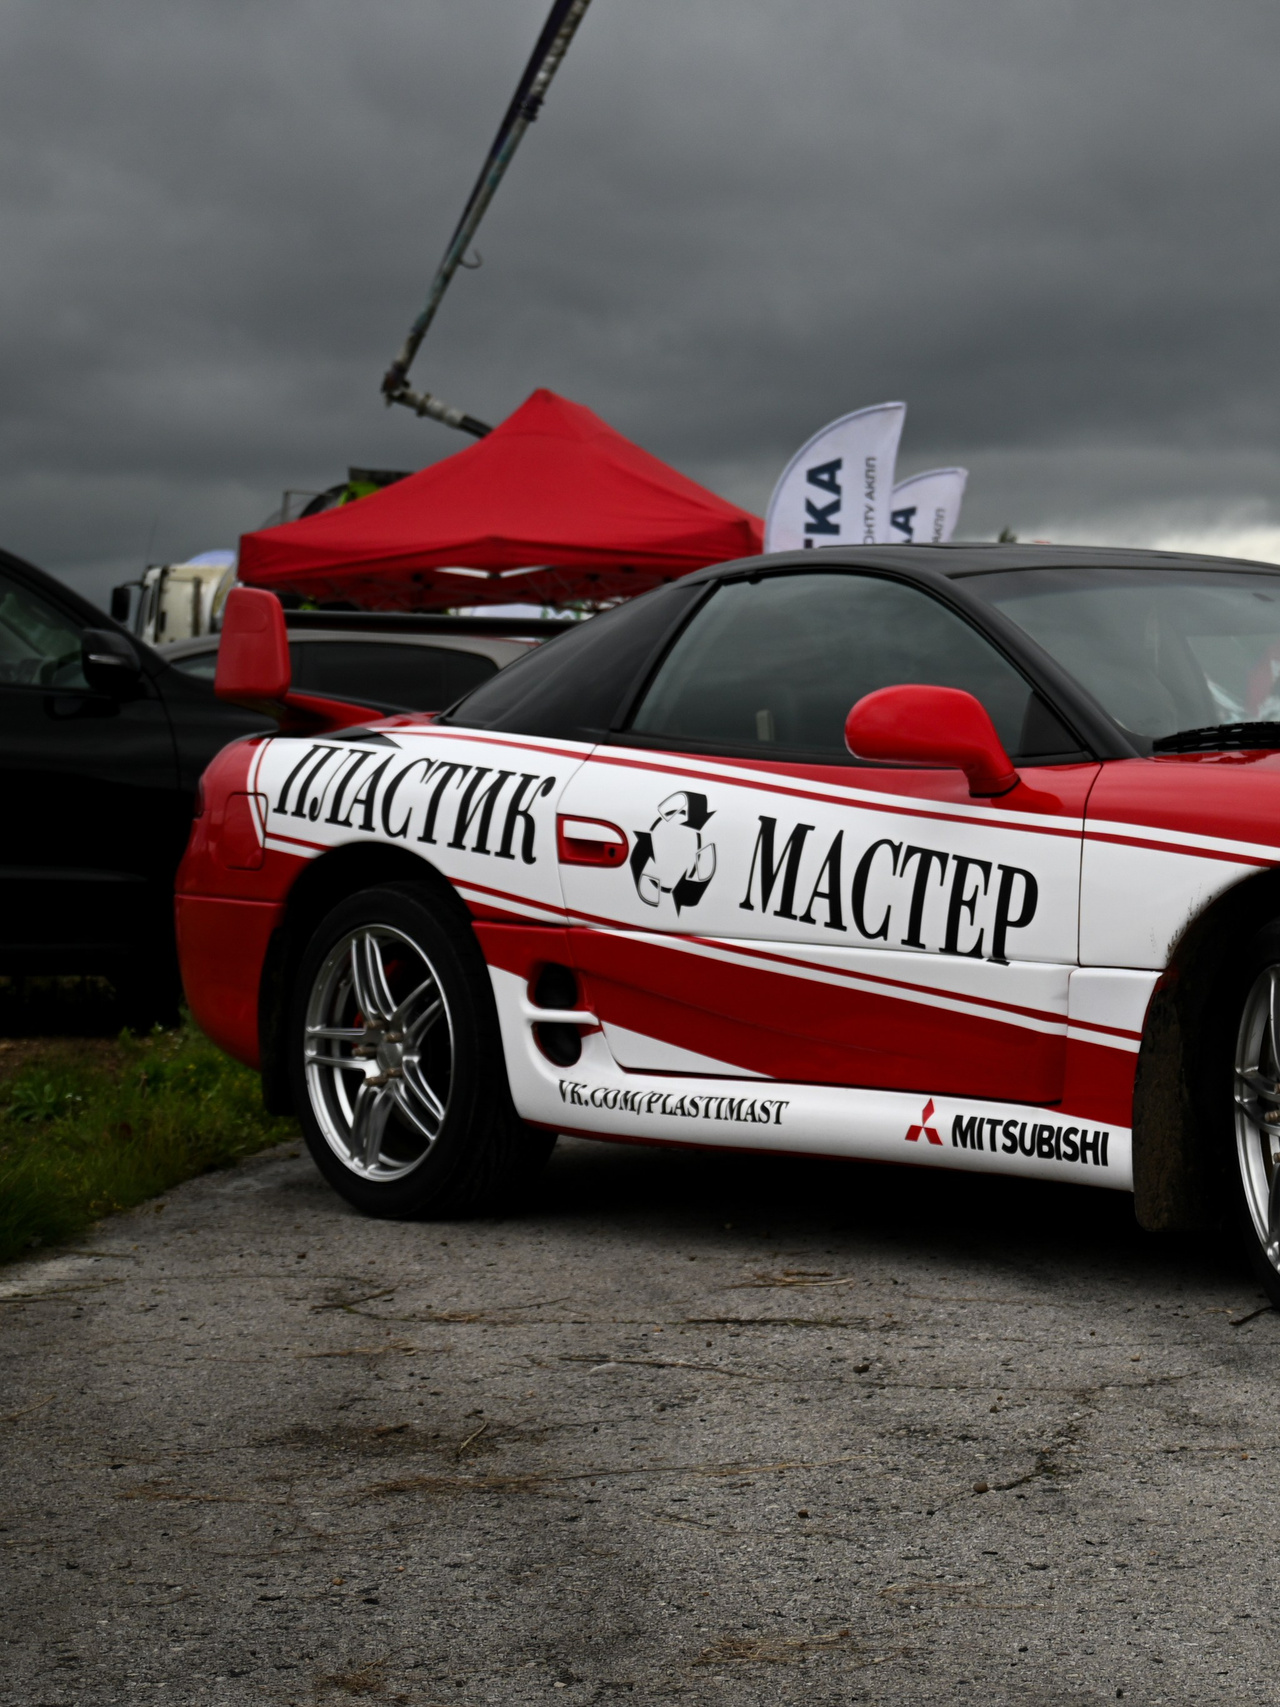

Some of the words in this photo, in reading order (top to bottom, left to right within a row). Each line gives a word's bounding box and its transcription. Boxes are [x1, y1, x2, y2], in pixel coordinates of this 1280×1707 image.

[865, 456, 876, 501] АКПП
[272, 744, 556, 865] ПЛАСТИК
[739, 815, 1039, 966] МАСТЕР
[558, 1079, 790, 1125] VK.COM/PLASTIMAST
[951, 1114, 1109, 1167] MITSUBISHI
